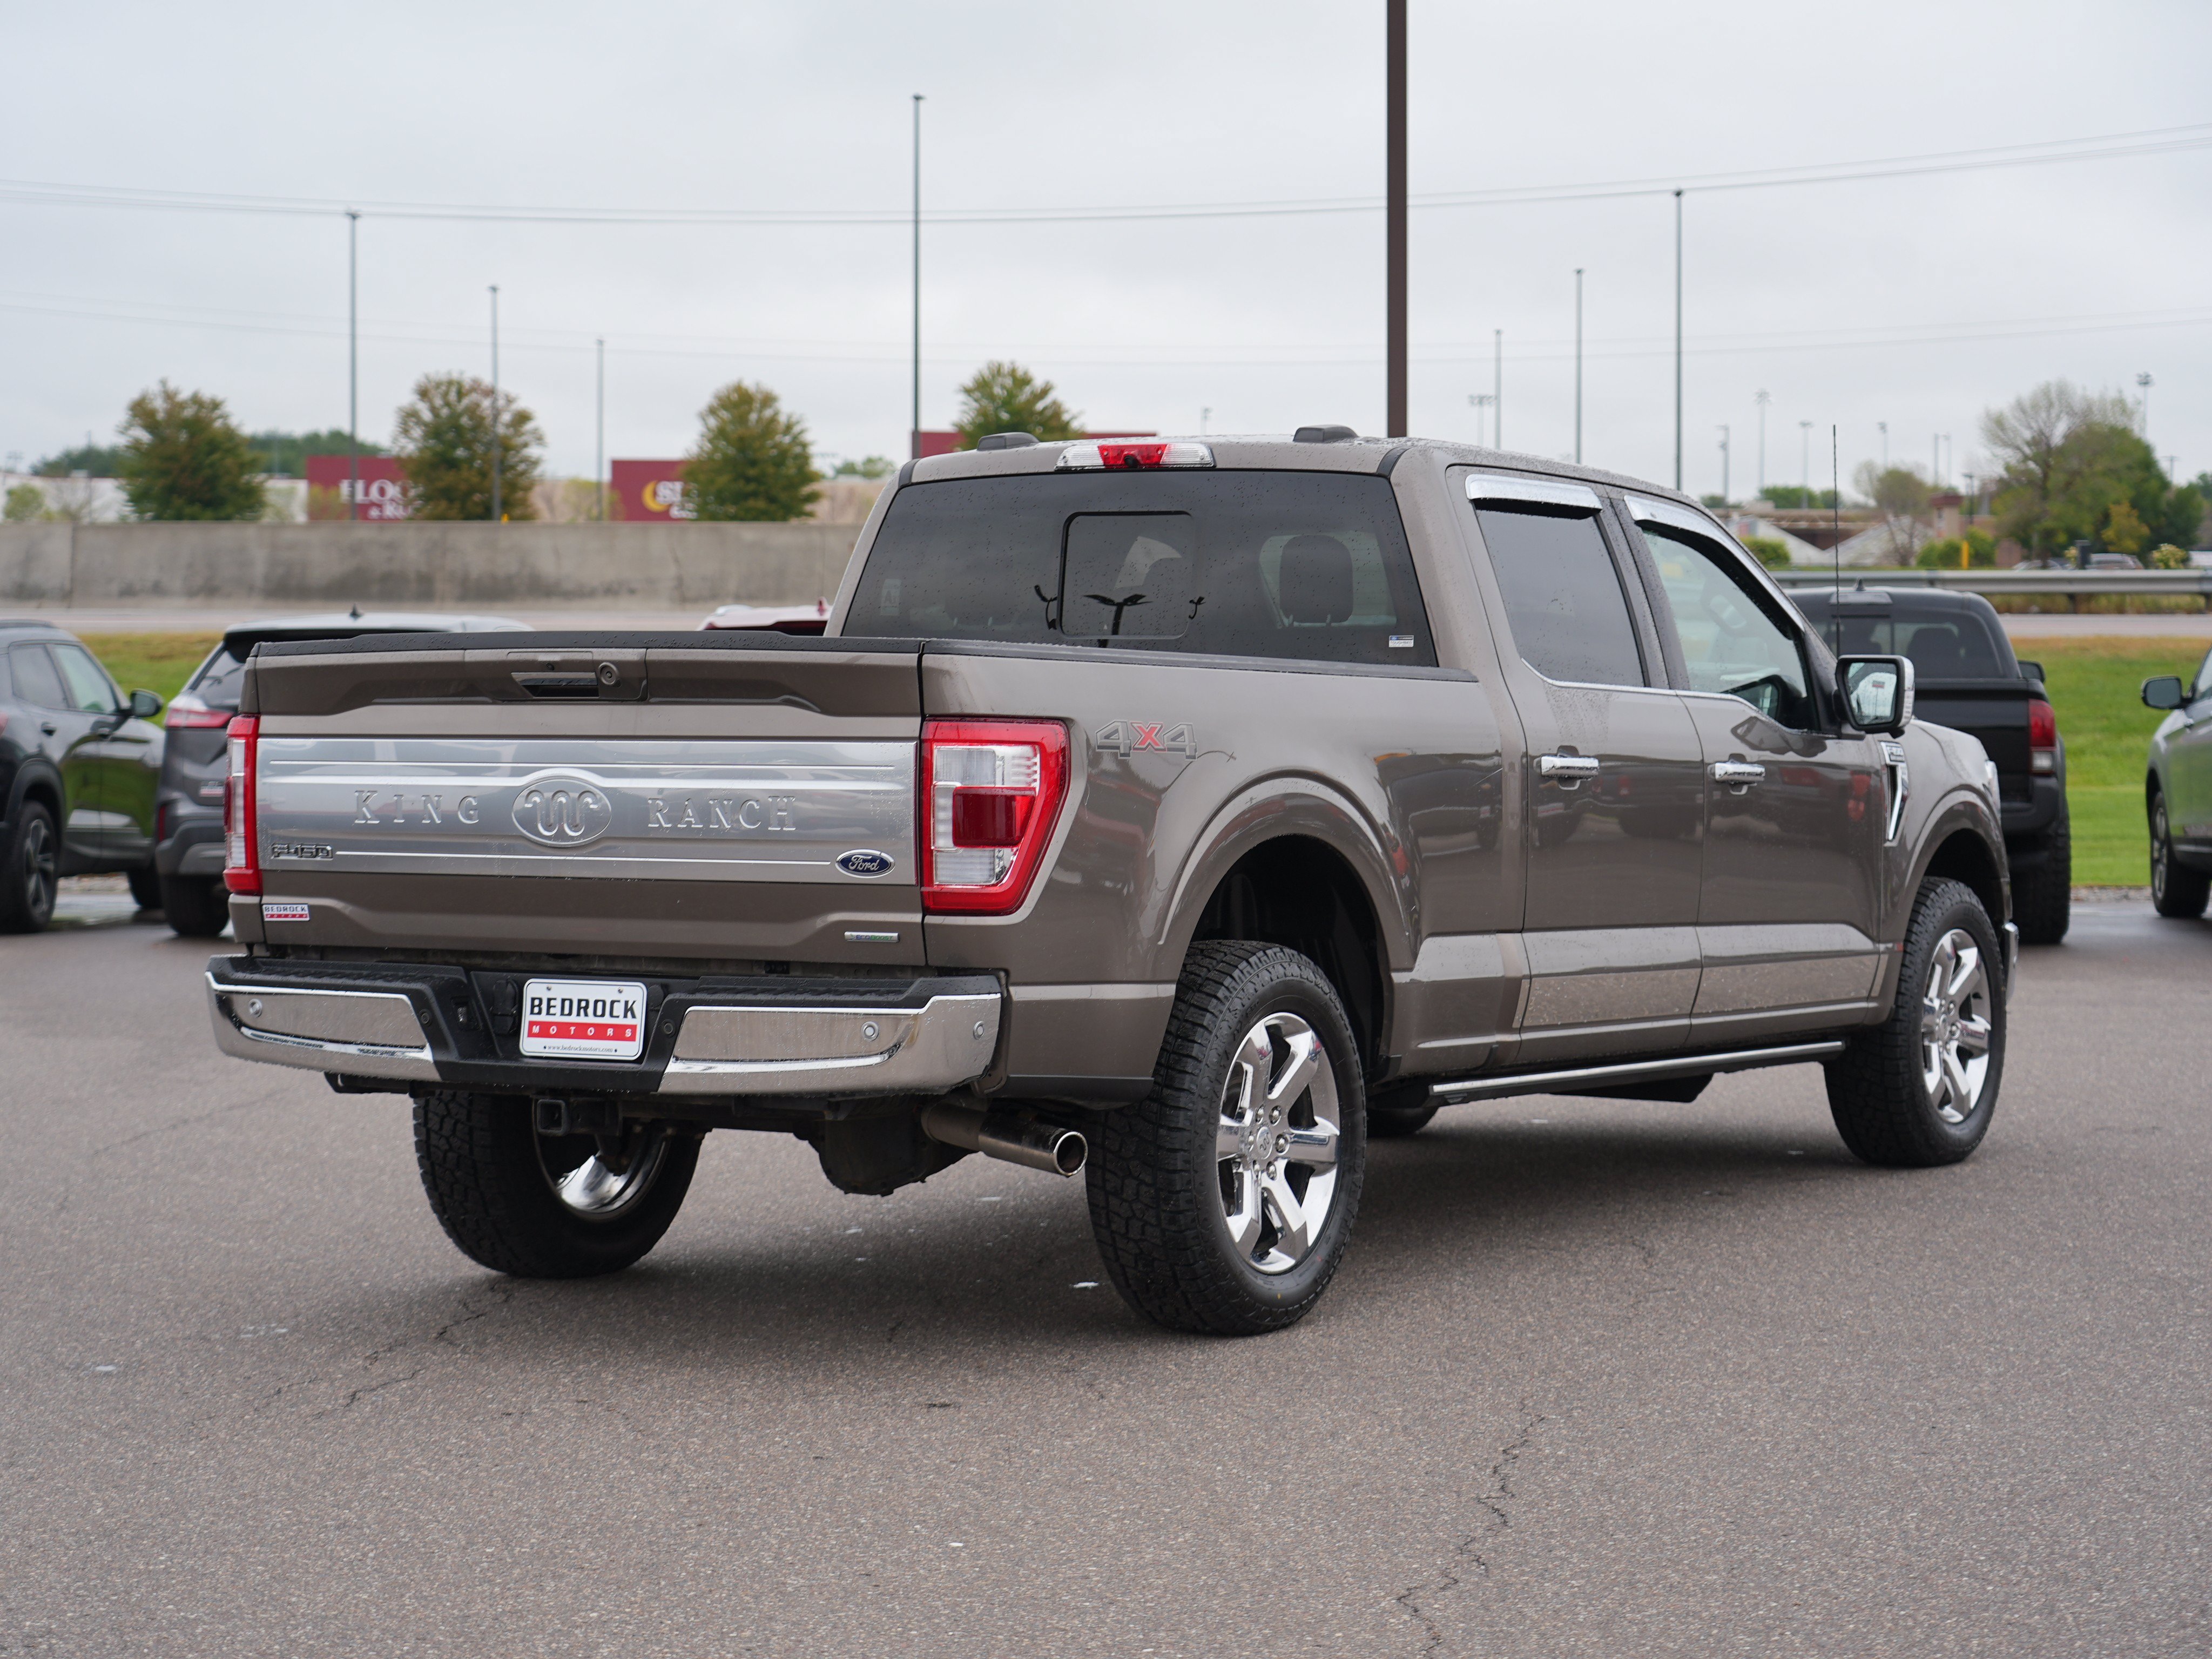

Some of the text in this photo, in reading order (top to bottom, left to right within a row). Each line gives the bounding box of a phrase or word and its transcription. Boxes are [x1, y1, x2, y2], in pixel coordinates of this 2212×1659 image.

[354, 790, 796, 831] KING RANCH
[848, 854, 880, 871] Ford
[529, 997, 637, 1019] BEDROCK
[532, 1025, 632, 1038] MOTORS
[548, 1044, 613, 1053] www.bedrockmotors.com
